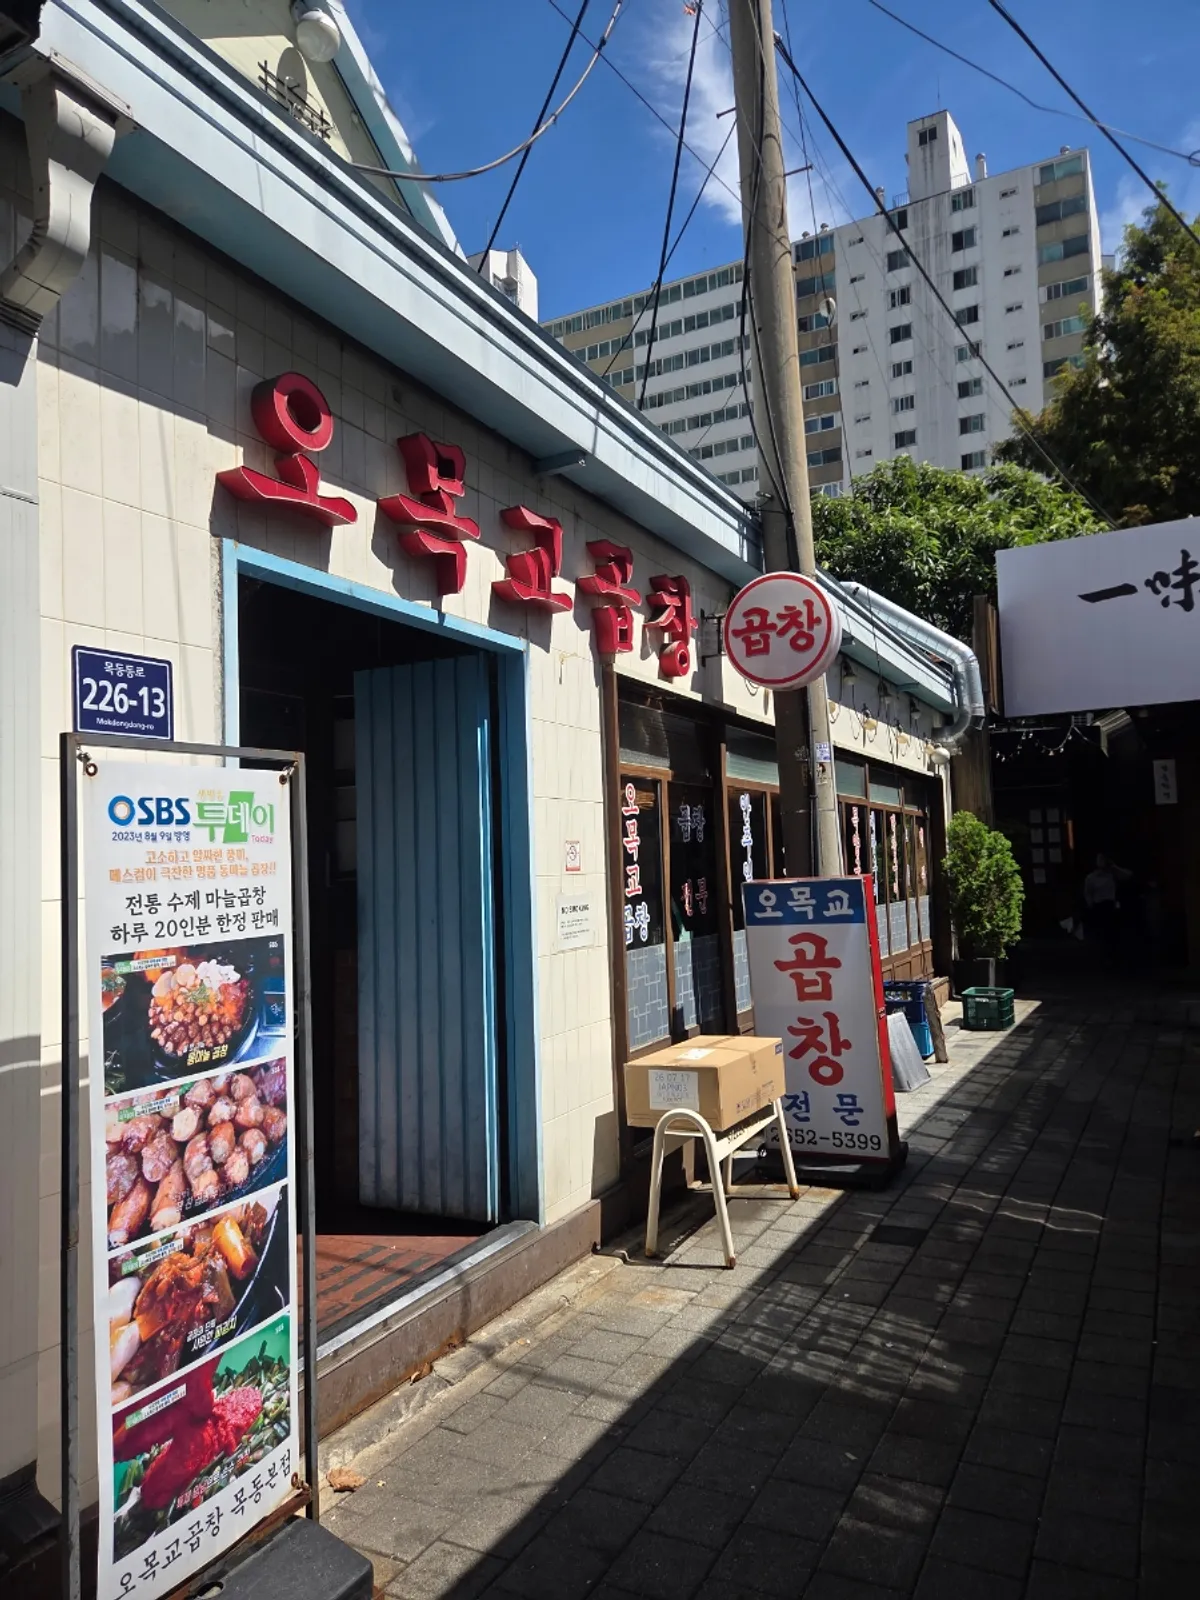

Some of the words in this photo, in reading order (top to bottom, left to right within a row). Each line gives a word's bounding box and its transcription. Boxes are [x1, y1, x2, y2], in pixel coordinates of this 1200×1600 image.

[731, 599, 822, 657] 곱창
[104, 661, 146, 678] 목동동로
[82, 677, 165, 718] 226-13
[137, 797, 191, 825] SBS
[192, 802, 274, 843] 투데이
[112, 831, 143, 842] 2023년
[144, 831, 157, 842] 8월
[159, 831, 172, 841] 9일
[622, 783, 642, 897] 오목교
[145, 850, 190, 864] 고소하고
[160, 865, 193, 880] 극찬한
[125, 893, 162, 916] 전통
[167, 889, 201, 913] 수제
[205, 885, 267, 909] 마늘곱창
[754, 886, 854, 920] 오목교
[110, 922, 149, 944] 하루
[154, 915, 212, 939] 20인분
[216, 910, 247, 934] 한정
[251, 908, 279, 930] 판매
[774, 932, 852, 1086] 곱창
[784, 1091, 864, 1126] 전문
[114, 1507, 224, 1600] 오목교곱창
[230, 1448, 292, 1517] 목동본점
